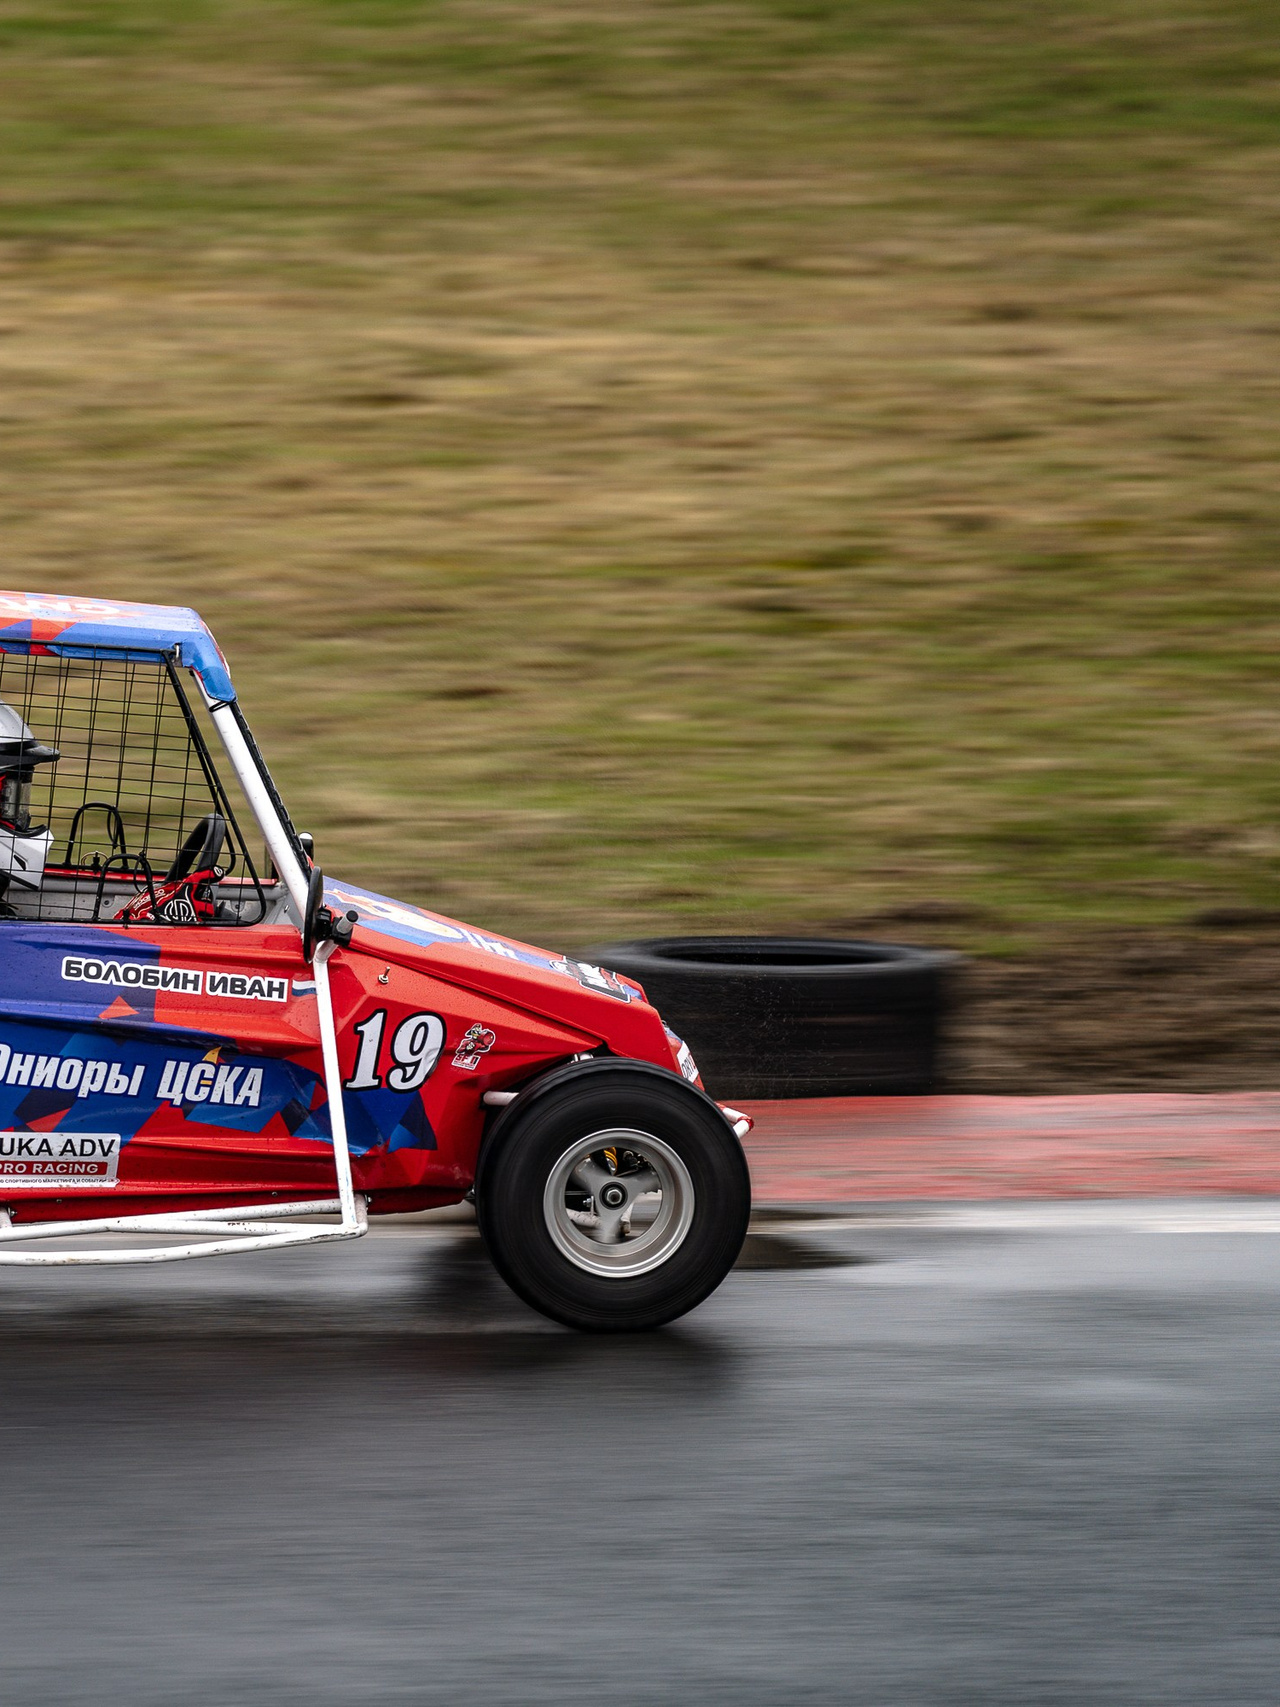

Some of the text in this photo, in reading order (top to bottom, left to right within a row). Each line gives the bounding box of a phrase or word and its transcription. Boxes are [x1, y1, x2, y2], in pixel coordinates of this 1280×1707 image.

[64, 959, 285, 999] БОЛОБИН ИВАН
[345, 1009, 447, 1092] 19
[156, 1059, 264, 1107] ЦСКА
[58, 1138, 116, 1158] ADV
[32, 1162, 99, 1175] RACING
